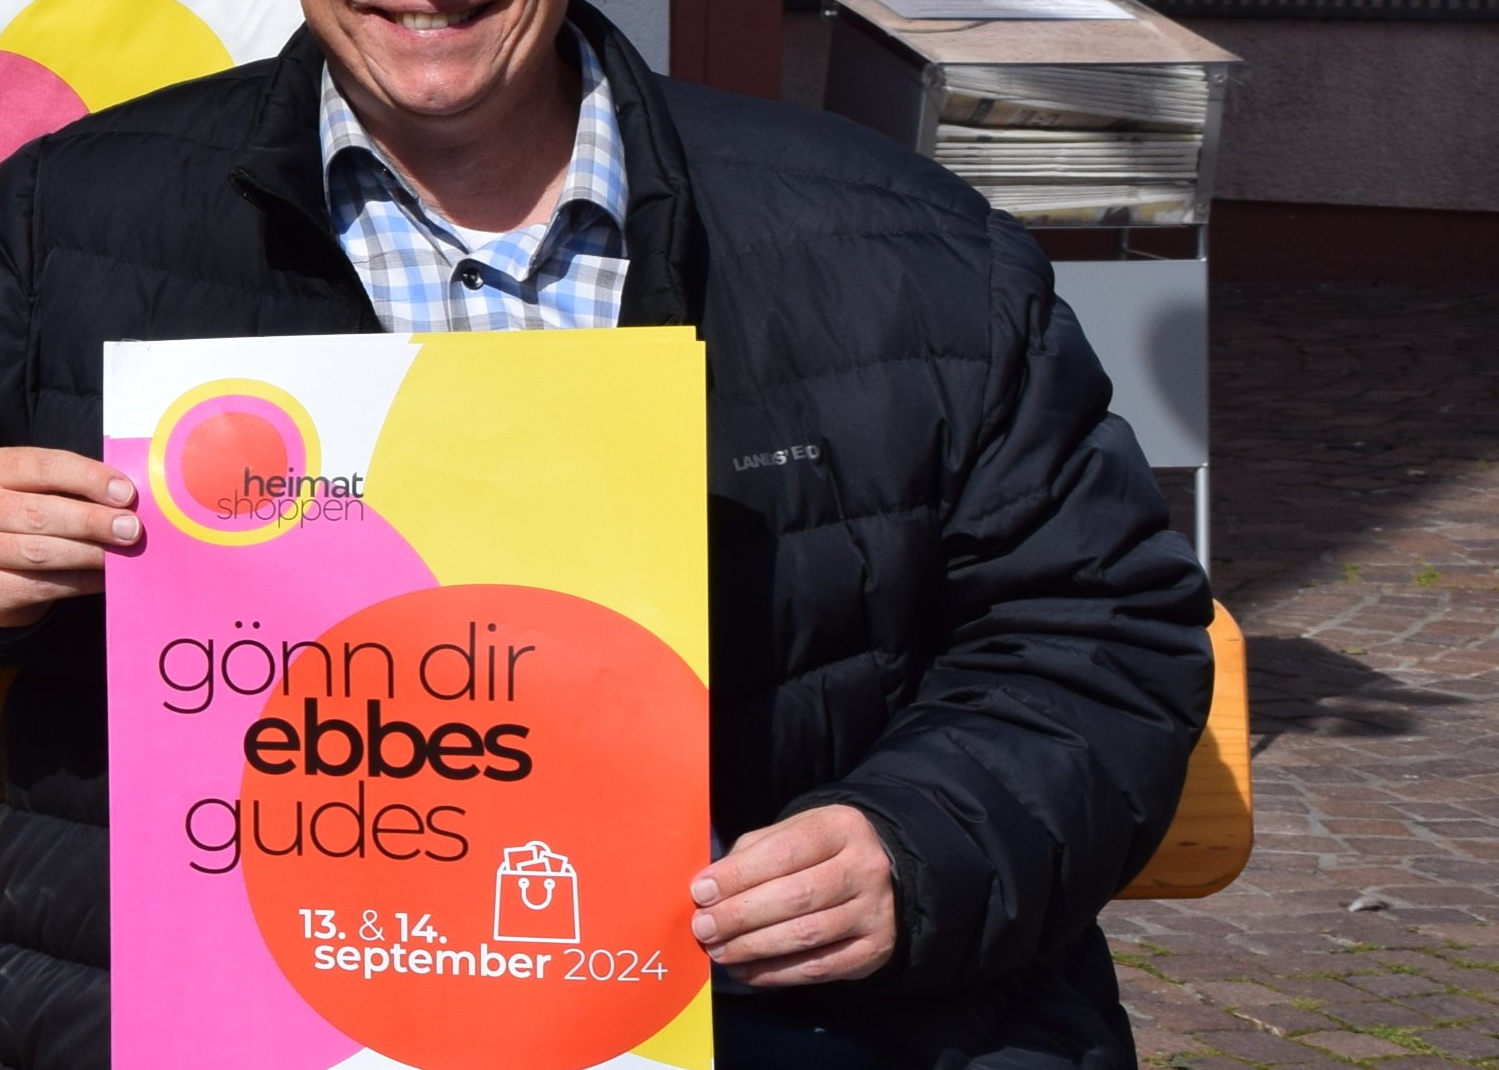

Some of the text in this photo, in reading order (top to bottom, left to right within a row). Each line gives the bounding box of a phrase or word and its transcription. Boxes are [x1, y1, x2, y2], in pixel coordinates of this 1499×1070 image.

[244, 466, 364, 499] heimat
[217, 489, 364, 529] shoppen
[159, 621, 536, 715] gönn dir
[244, 698, 534, 782] ebbes
[185, 781, 470, 875] gudes
[299, 908, 449, 944] 13. & 14.
[314, 943, 668, 982] september 2024
